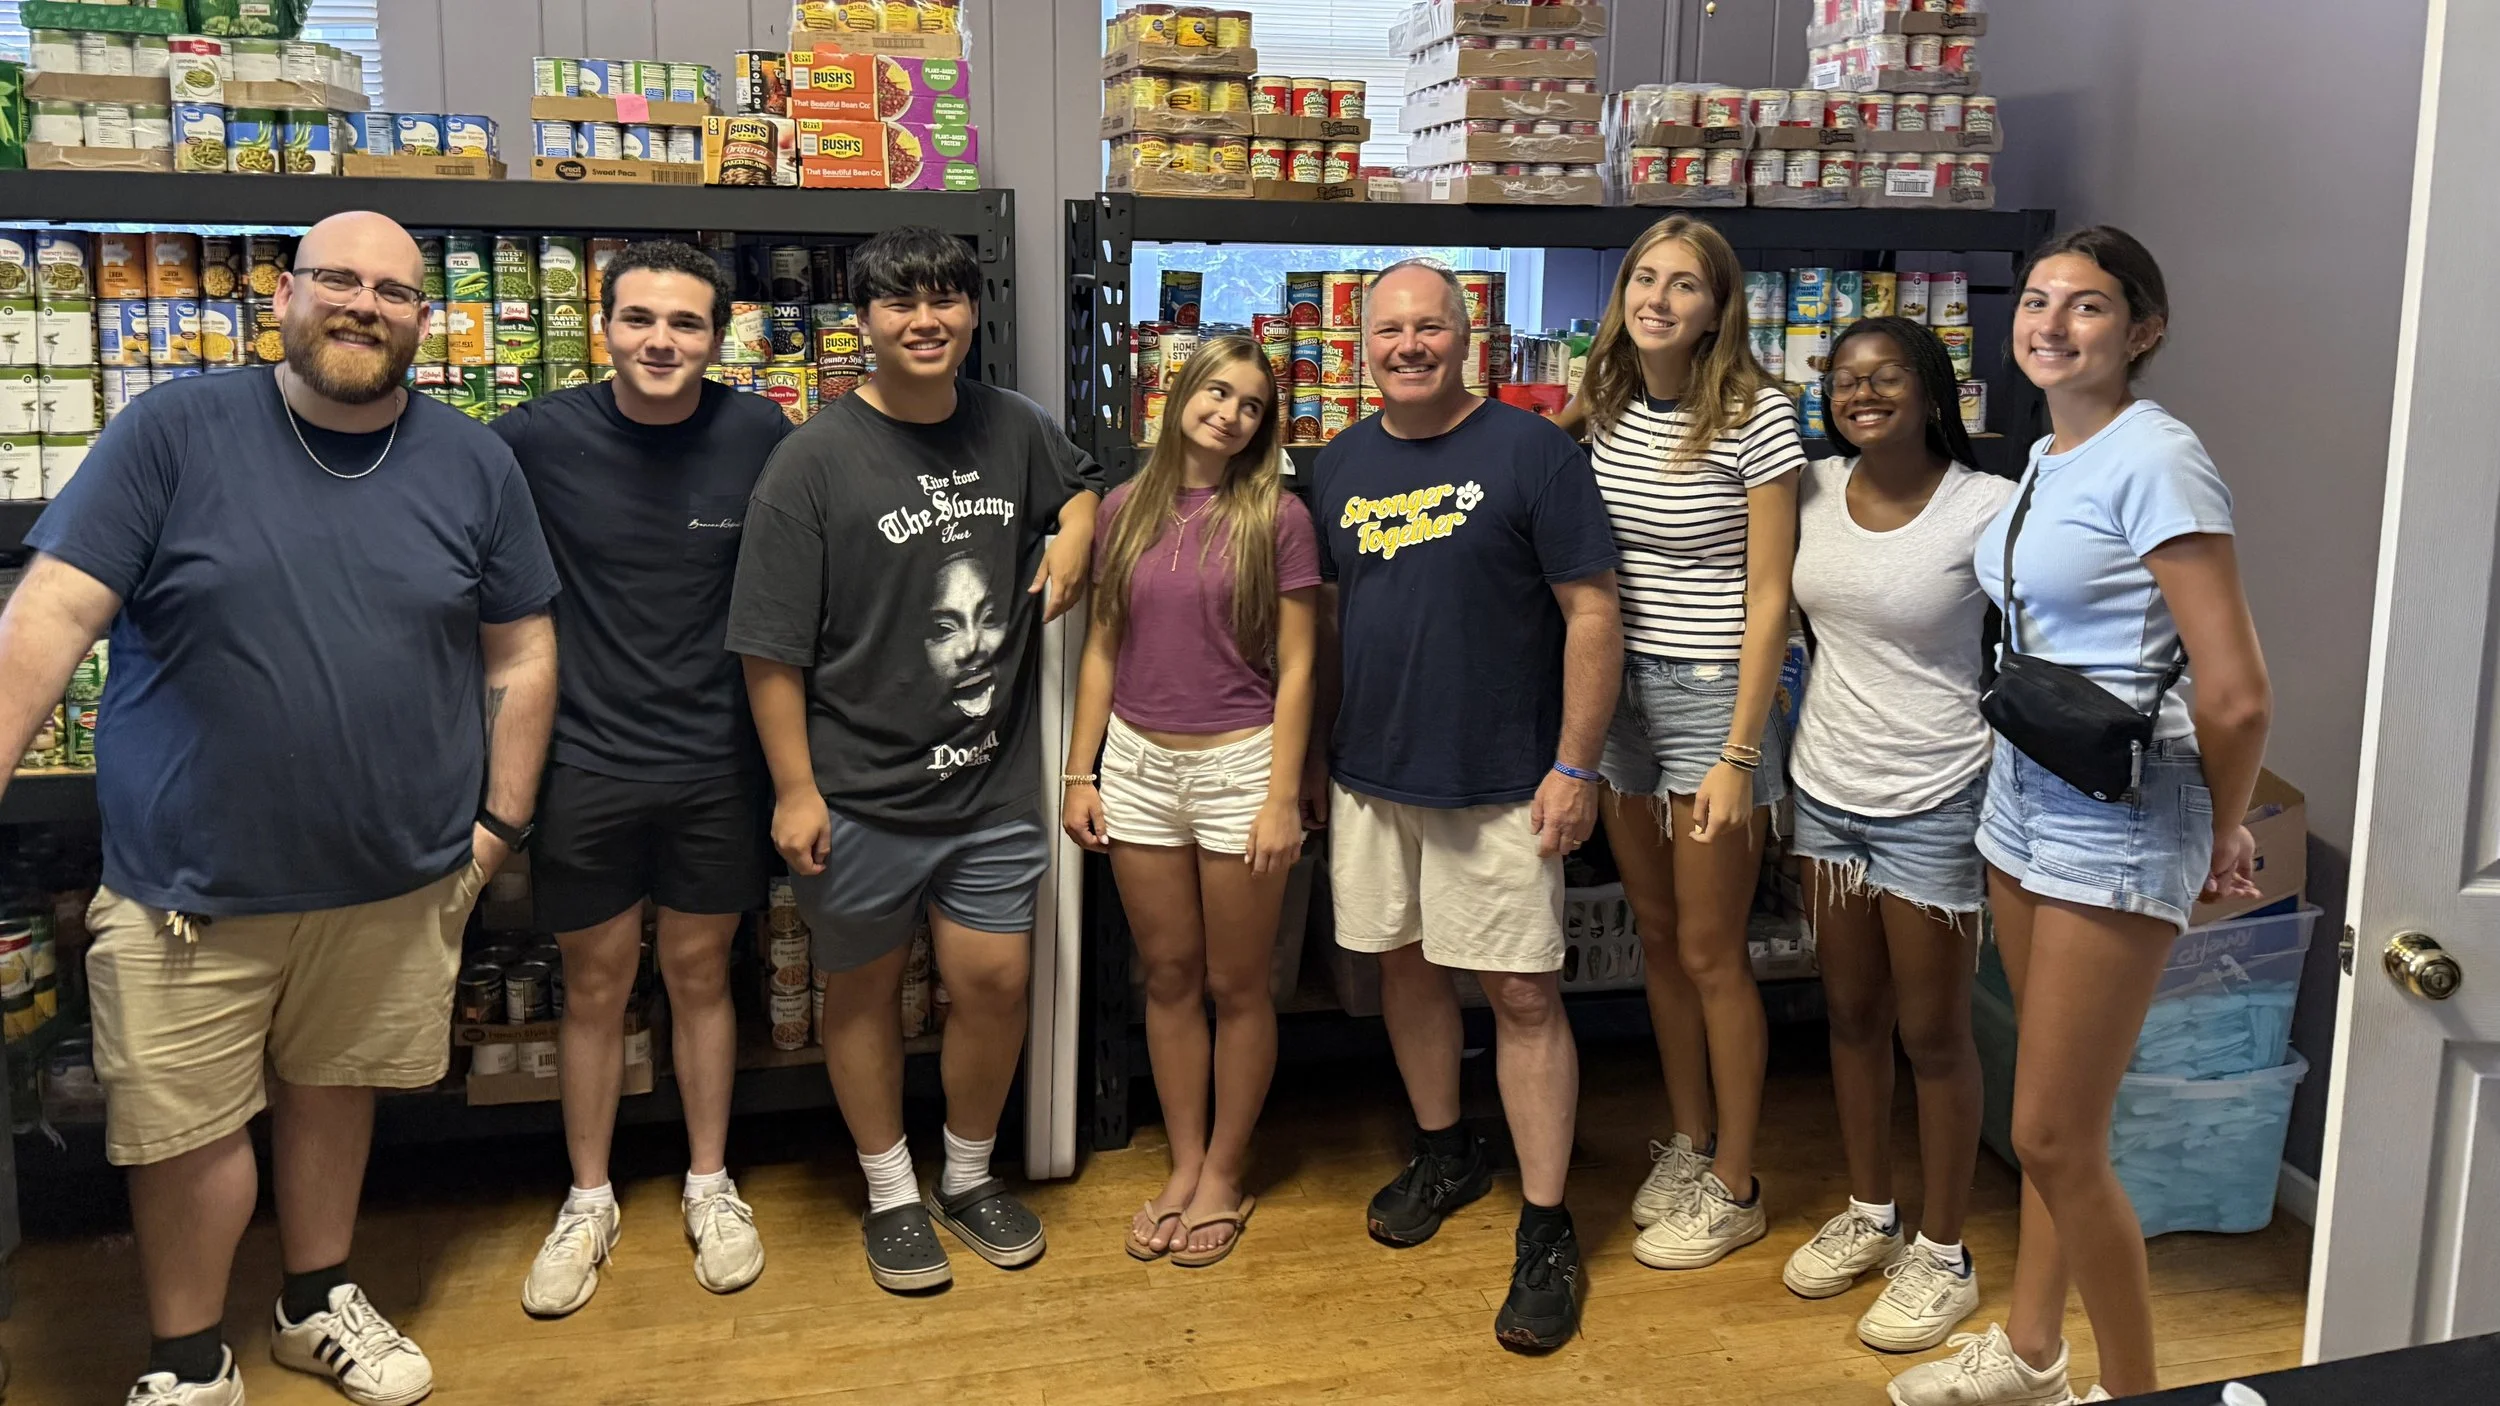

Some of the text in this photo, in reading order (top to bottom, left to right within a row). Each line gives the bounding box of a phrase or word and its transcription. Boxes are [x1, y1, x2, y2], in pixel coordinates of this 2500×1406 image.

[814, 71, 852, 85] BUSH'S
[810, 100, 840, 108] Beautiful
[709, 118, 718, 129] 8
[730, 123, 767, 139] BUSH'S
[822, 139, 860, 152] BUSH'S
[726, 145, 768, 158] Original
[559, 165, 582, 173] Great
[592, 168, 637, 178] Sweet Peas
[822, 168, 852, 177] Beautiful
[504, 306, 525, 314] Libby's
[772, 306, 800, 317] OYA
[518, 323, 536, 331] Peas
[1263, 326, 1289, 336] CHUNKY
[825, 338, 857, 348] BUSH'S
[1173, 343, 1196, 351] HOME
[820, 355, 863, 365] Country Style
[1173, 351, 1193, 360] STYL
[420, 370, 441, 379] Libby's
[496, 371, 516, 379] ibby's
[767, 375, 796, 386] LUCK'S
[508, 388, 527, 396] Peas
[1959, 387, 1978, 395] OYAL
[917, 470, 980, 495] Live from
[1340, 483, 1456, 528] Stronger
[878, 490, 1015, 544] The Swamp
[941, 521, 972, 544] Tour
[1357, 511, 1468, 560] Together
